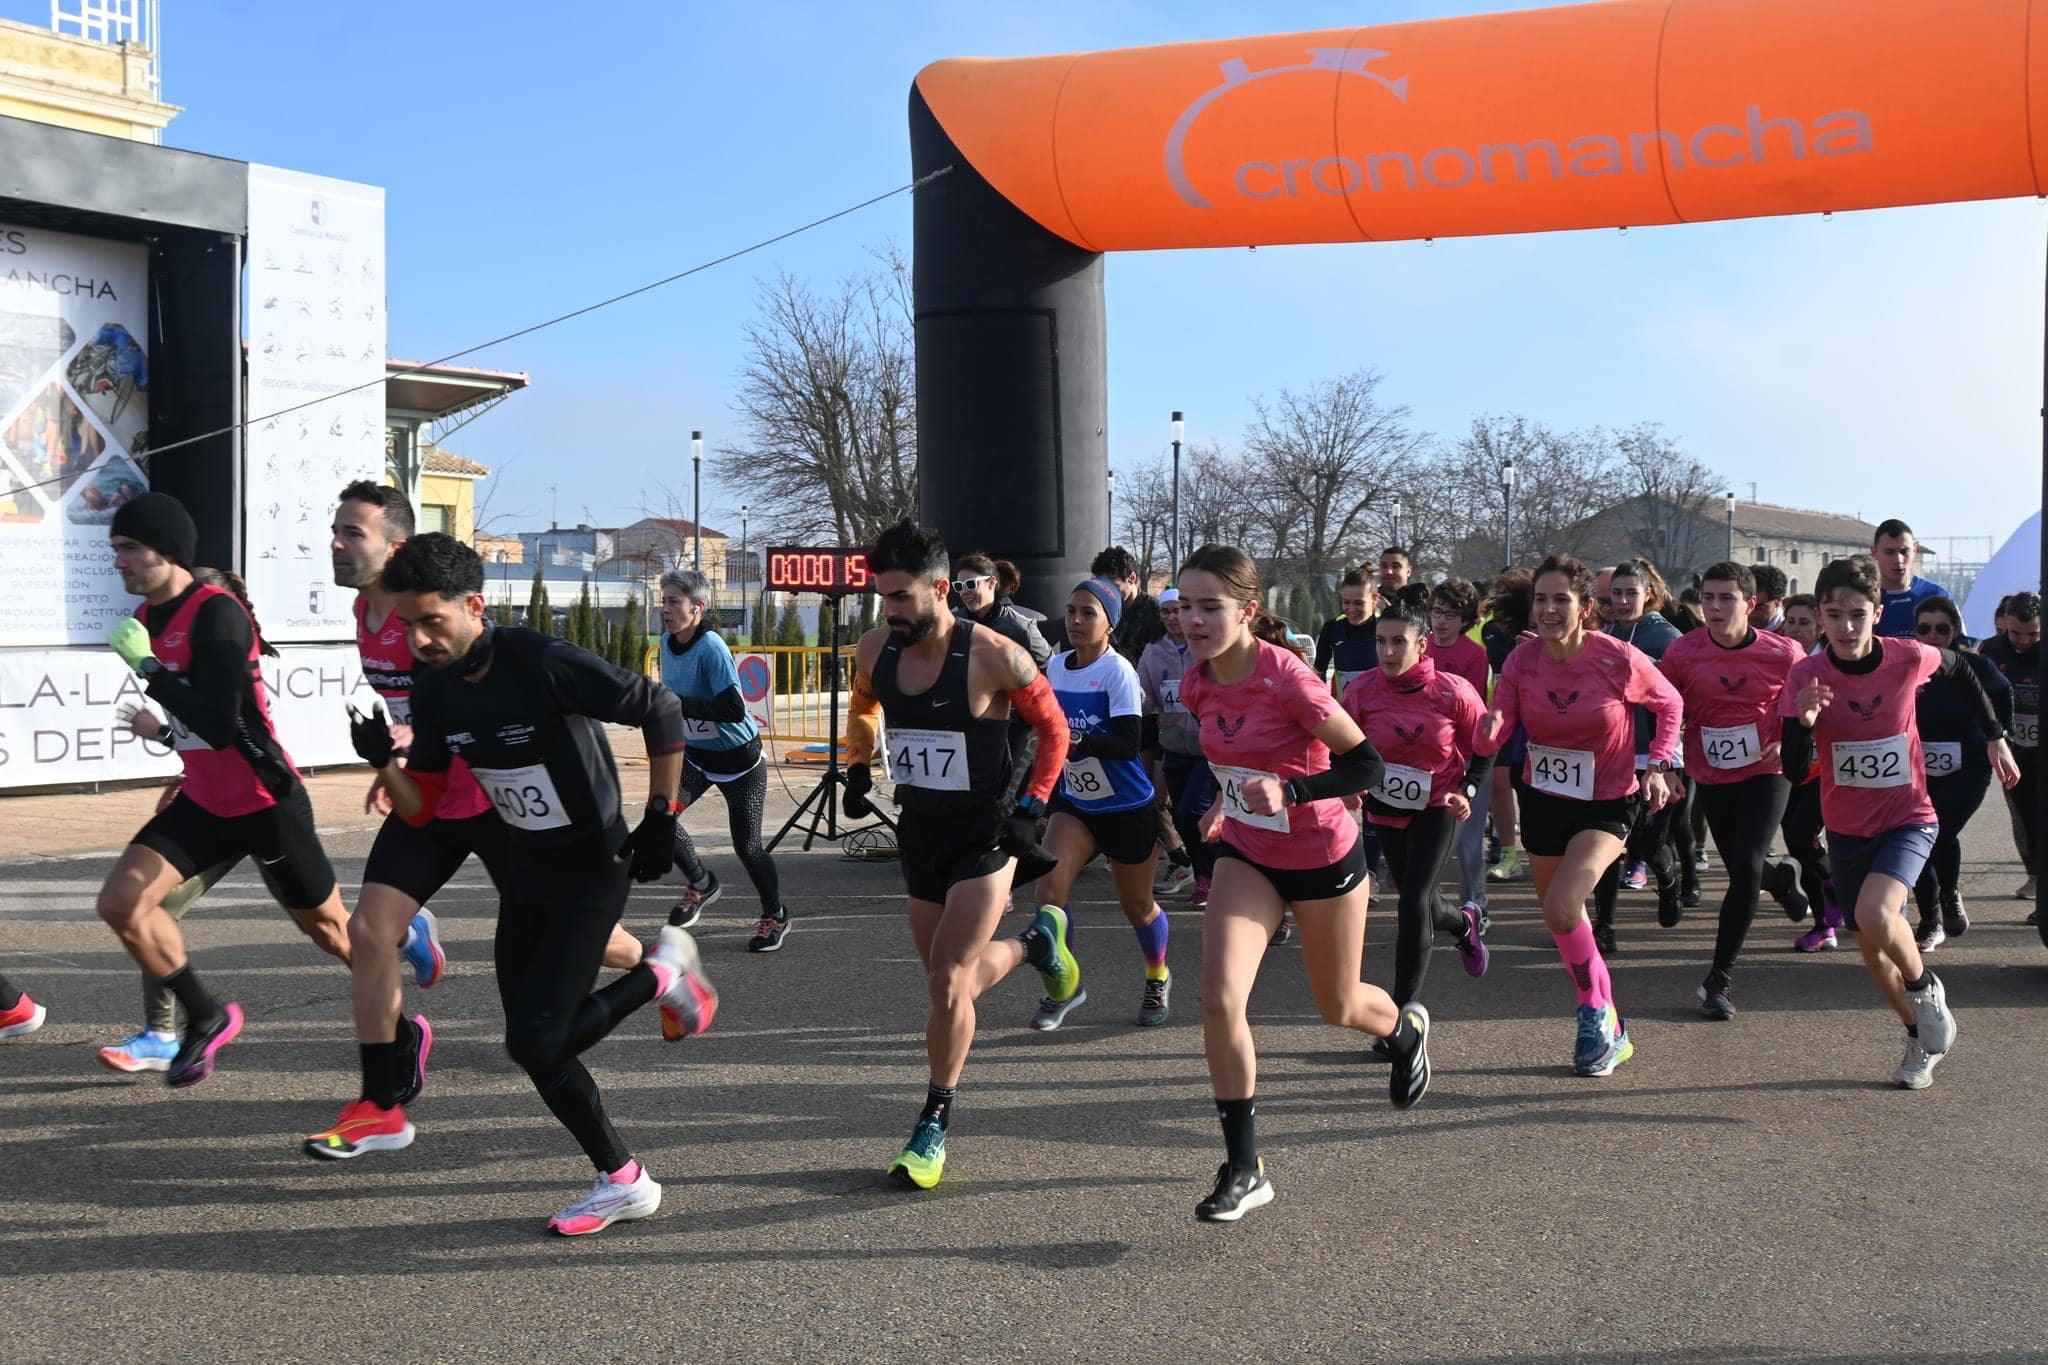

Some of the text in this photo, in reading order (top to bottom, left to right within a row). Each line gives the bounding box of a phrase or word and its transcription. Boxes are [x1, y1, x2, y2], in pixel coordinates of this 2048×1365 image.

[1234, 104, 1873, 200] cronomancha
[896, 746, 956, 778] 417
[1707, 737, 1748, 761] 421
[1536, 757, 1581, 787] 431
[1839, 752, 1900, 779] 432
[494, 785, 549, 818] 403
